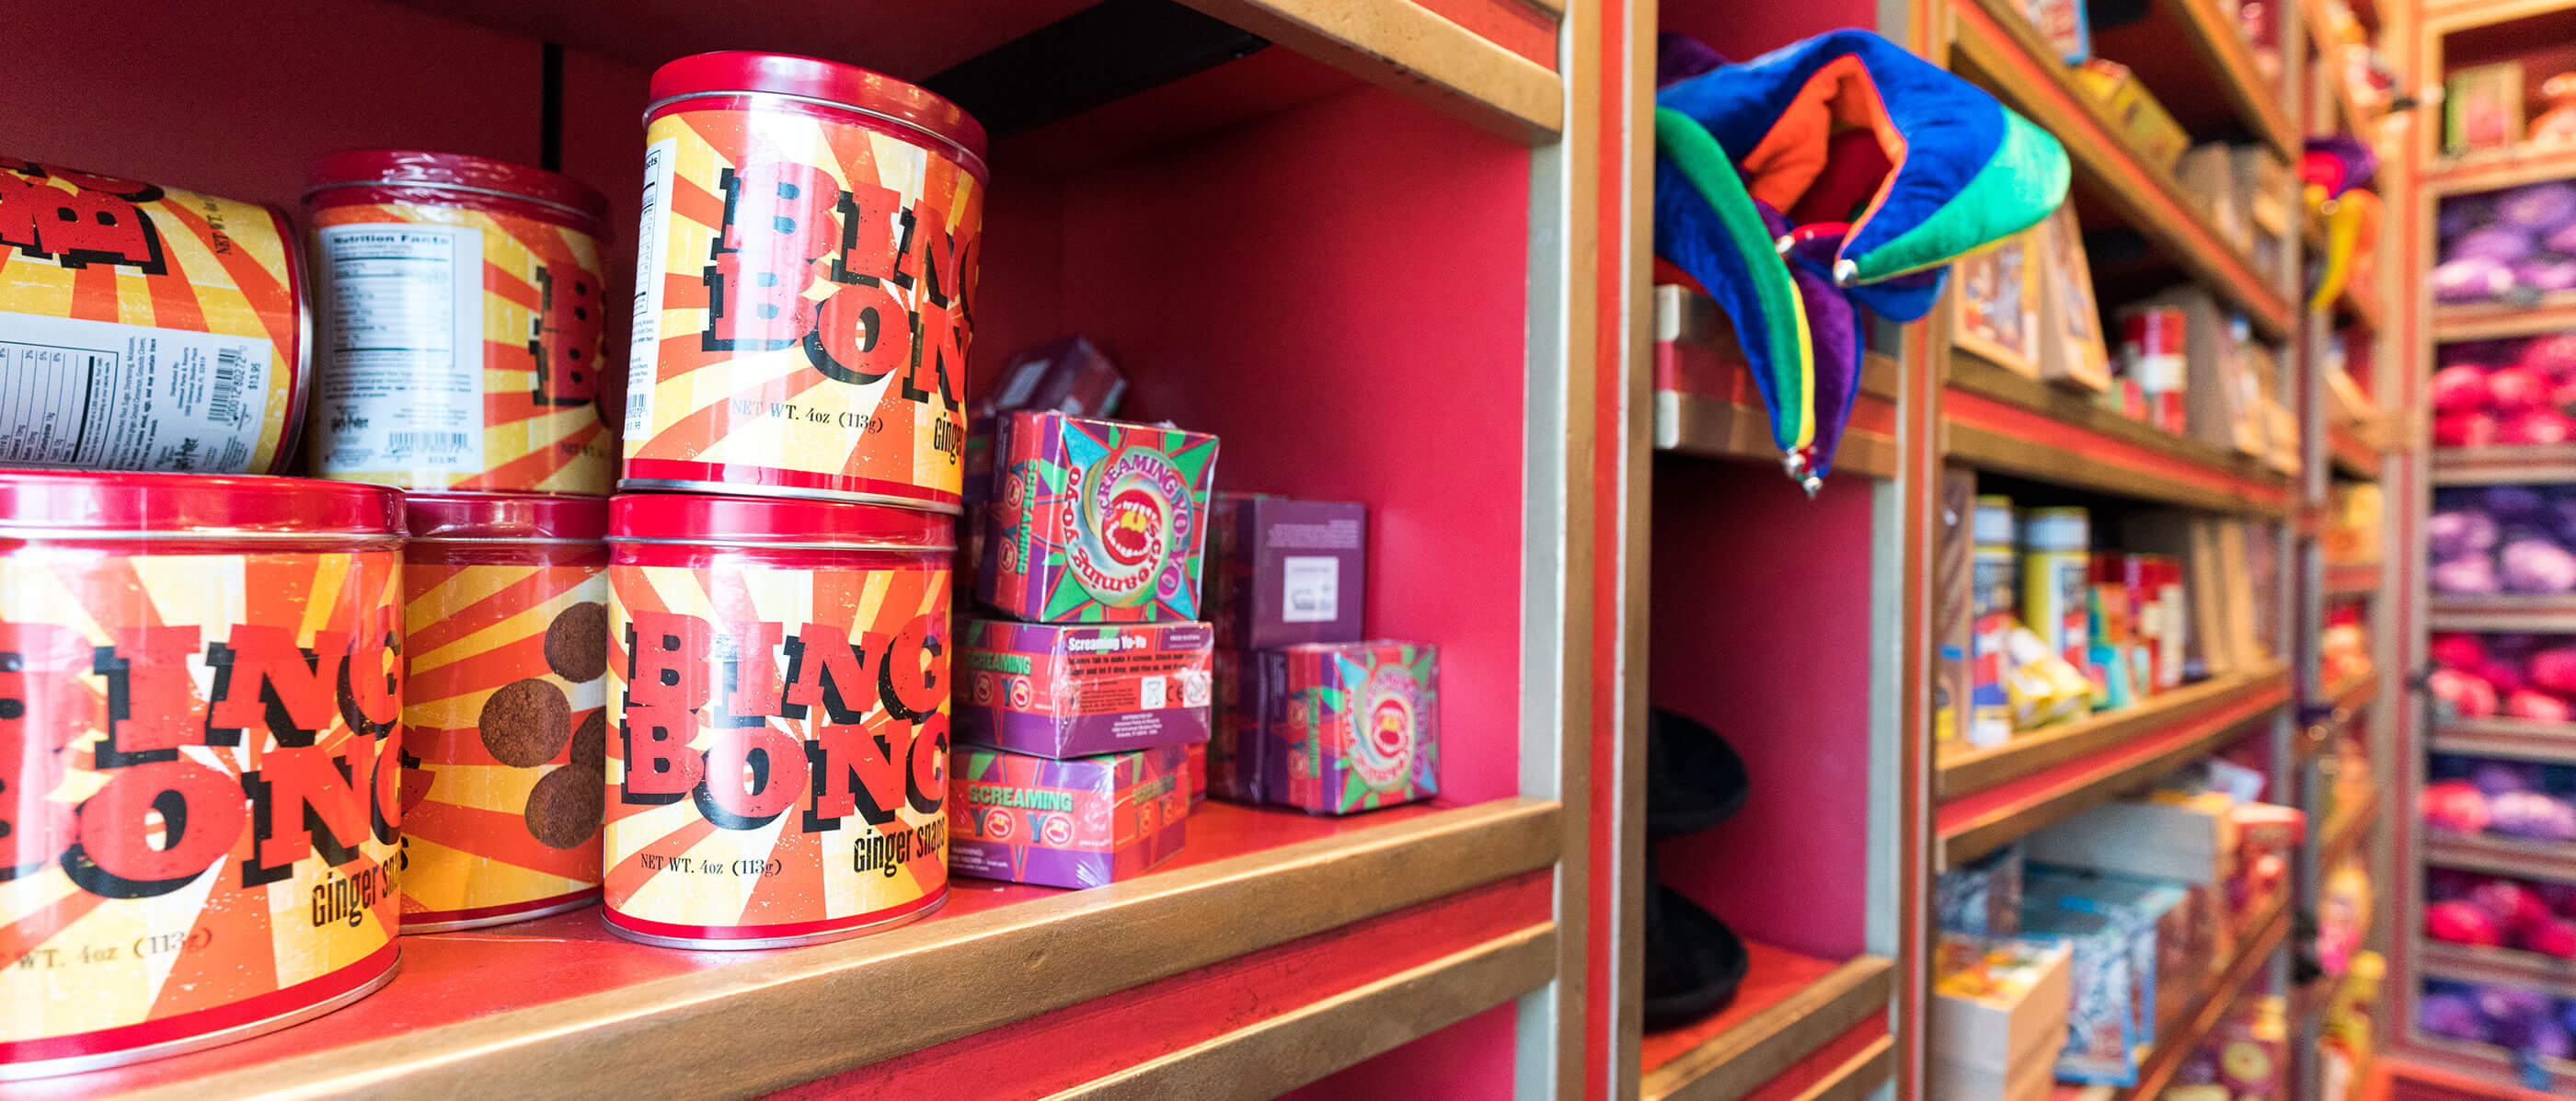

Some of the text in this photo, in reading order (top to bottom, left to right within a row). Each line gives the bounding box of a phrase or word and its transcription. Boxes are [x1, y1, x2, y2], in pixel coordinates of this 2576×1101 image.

[702, 250, 972, 412] BON
[247, 361, 260, 389] $13.95
[733, 399, 883, 434] NET WT. 4oz (113g)
[1098, 453, 1179, 519] SCREAMING
[1016, 459, 1038, 575] SCREAMING
[1068, 635, 1147, 651] Screaming Yo-Yo
[625, 610, 951, 724] BING
[967, 652, 1032, 676] SCREAMING
[620, 706, 950, 832] BONG
[969, 785, 1075, 813] SCREAMING
[916, 816, 945, 862] snaps
[640, 853, 782, 877] NET WT. 4oz (113g)
[79, 945, 119, 964] 4oz
[133, 926, 213, 959] (113g)
